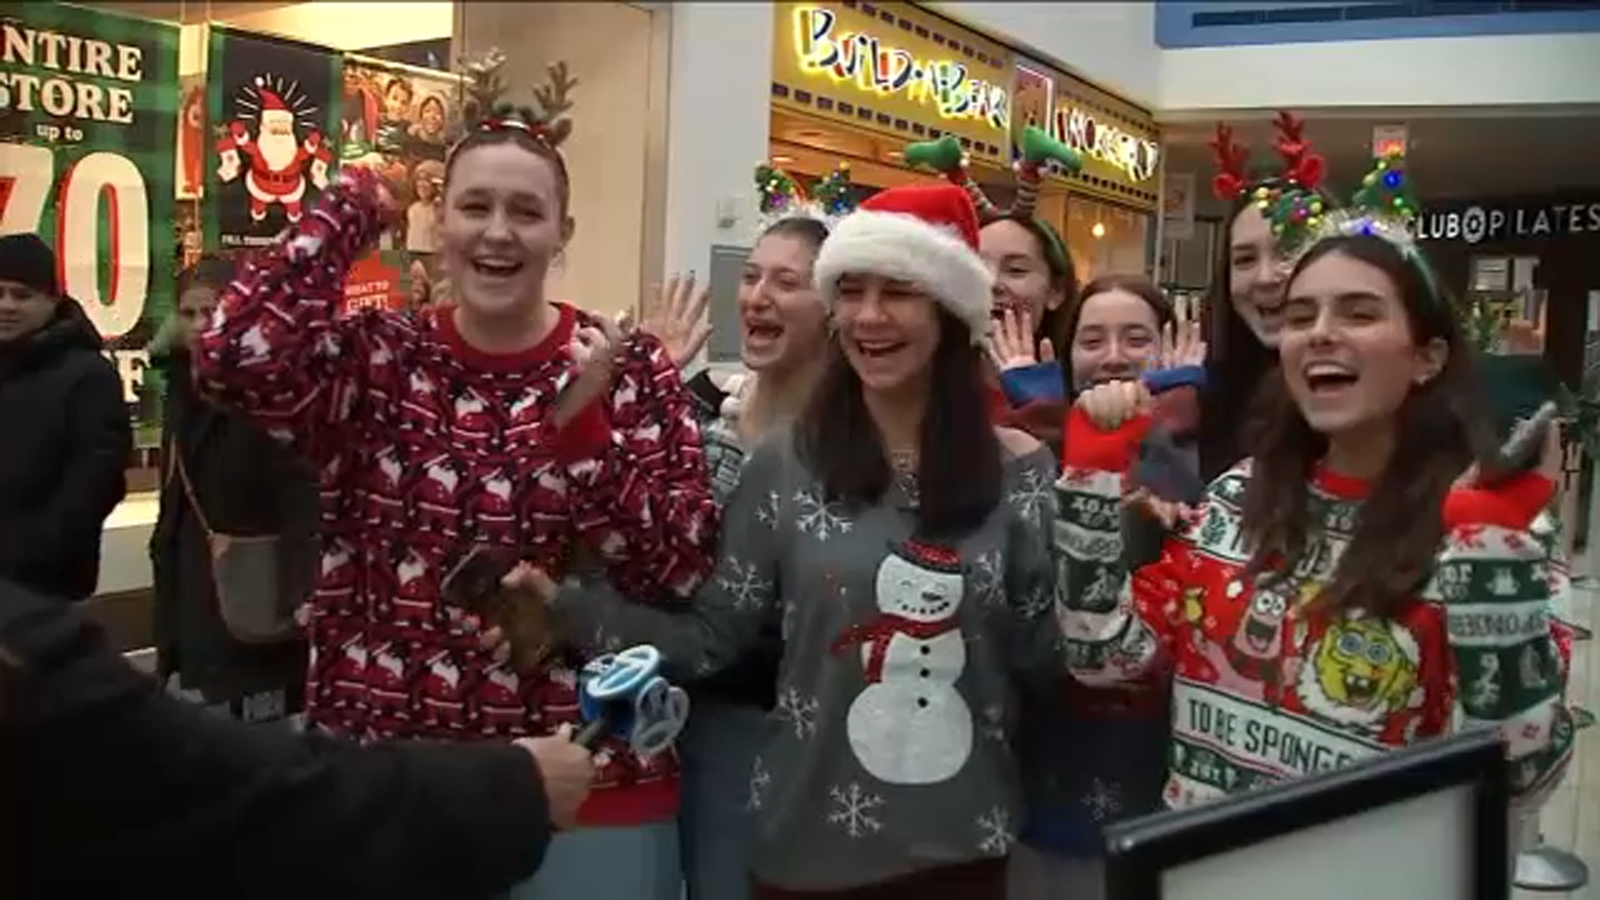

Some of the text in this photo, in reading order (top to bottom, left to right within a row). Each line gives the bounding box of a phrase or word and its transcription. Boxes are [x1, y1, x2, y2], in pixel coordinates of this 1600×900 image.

[36, 124, 83, 142] up to
[1410, 213, 1460, 239] LUB
[1188, 699, 1212, 733] TO
[1215, 707, 1239, 746] BE
